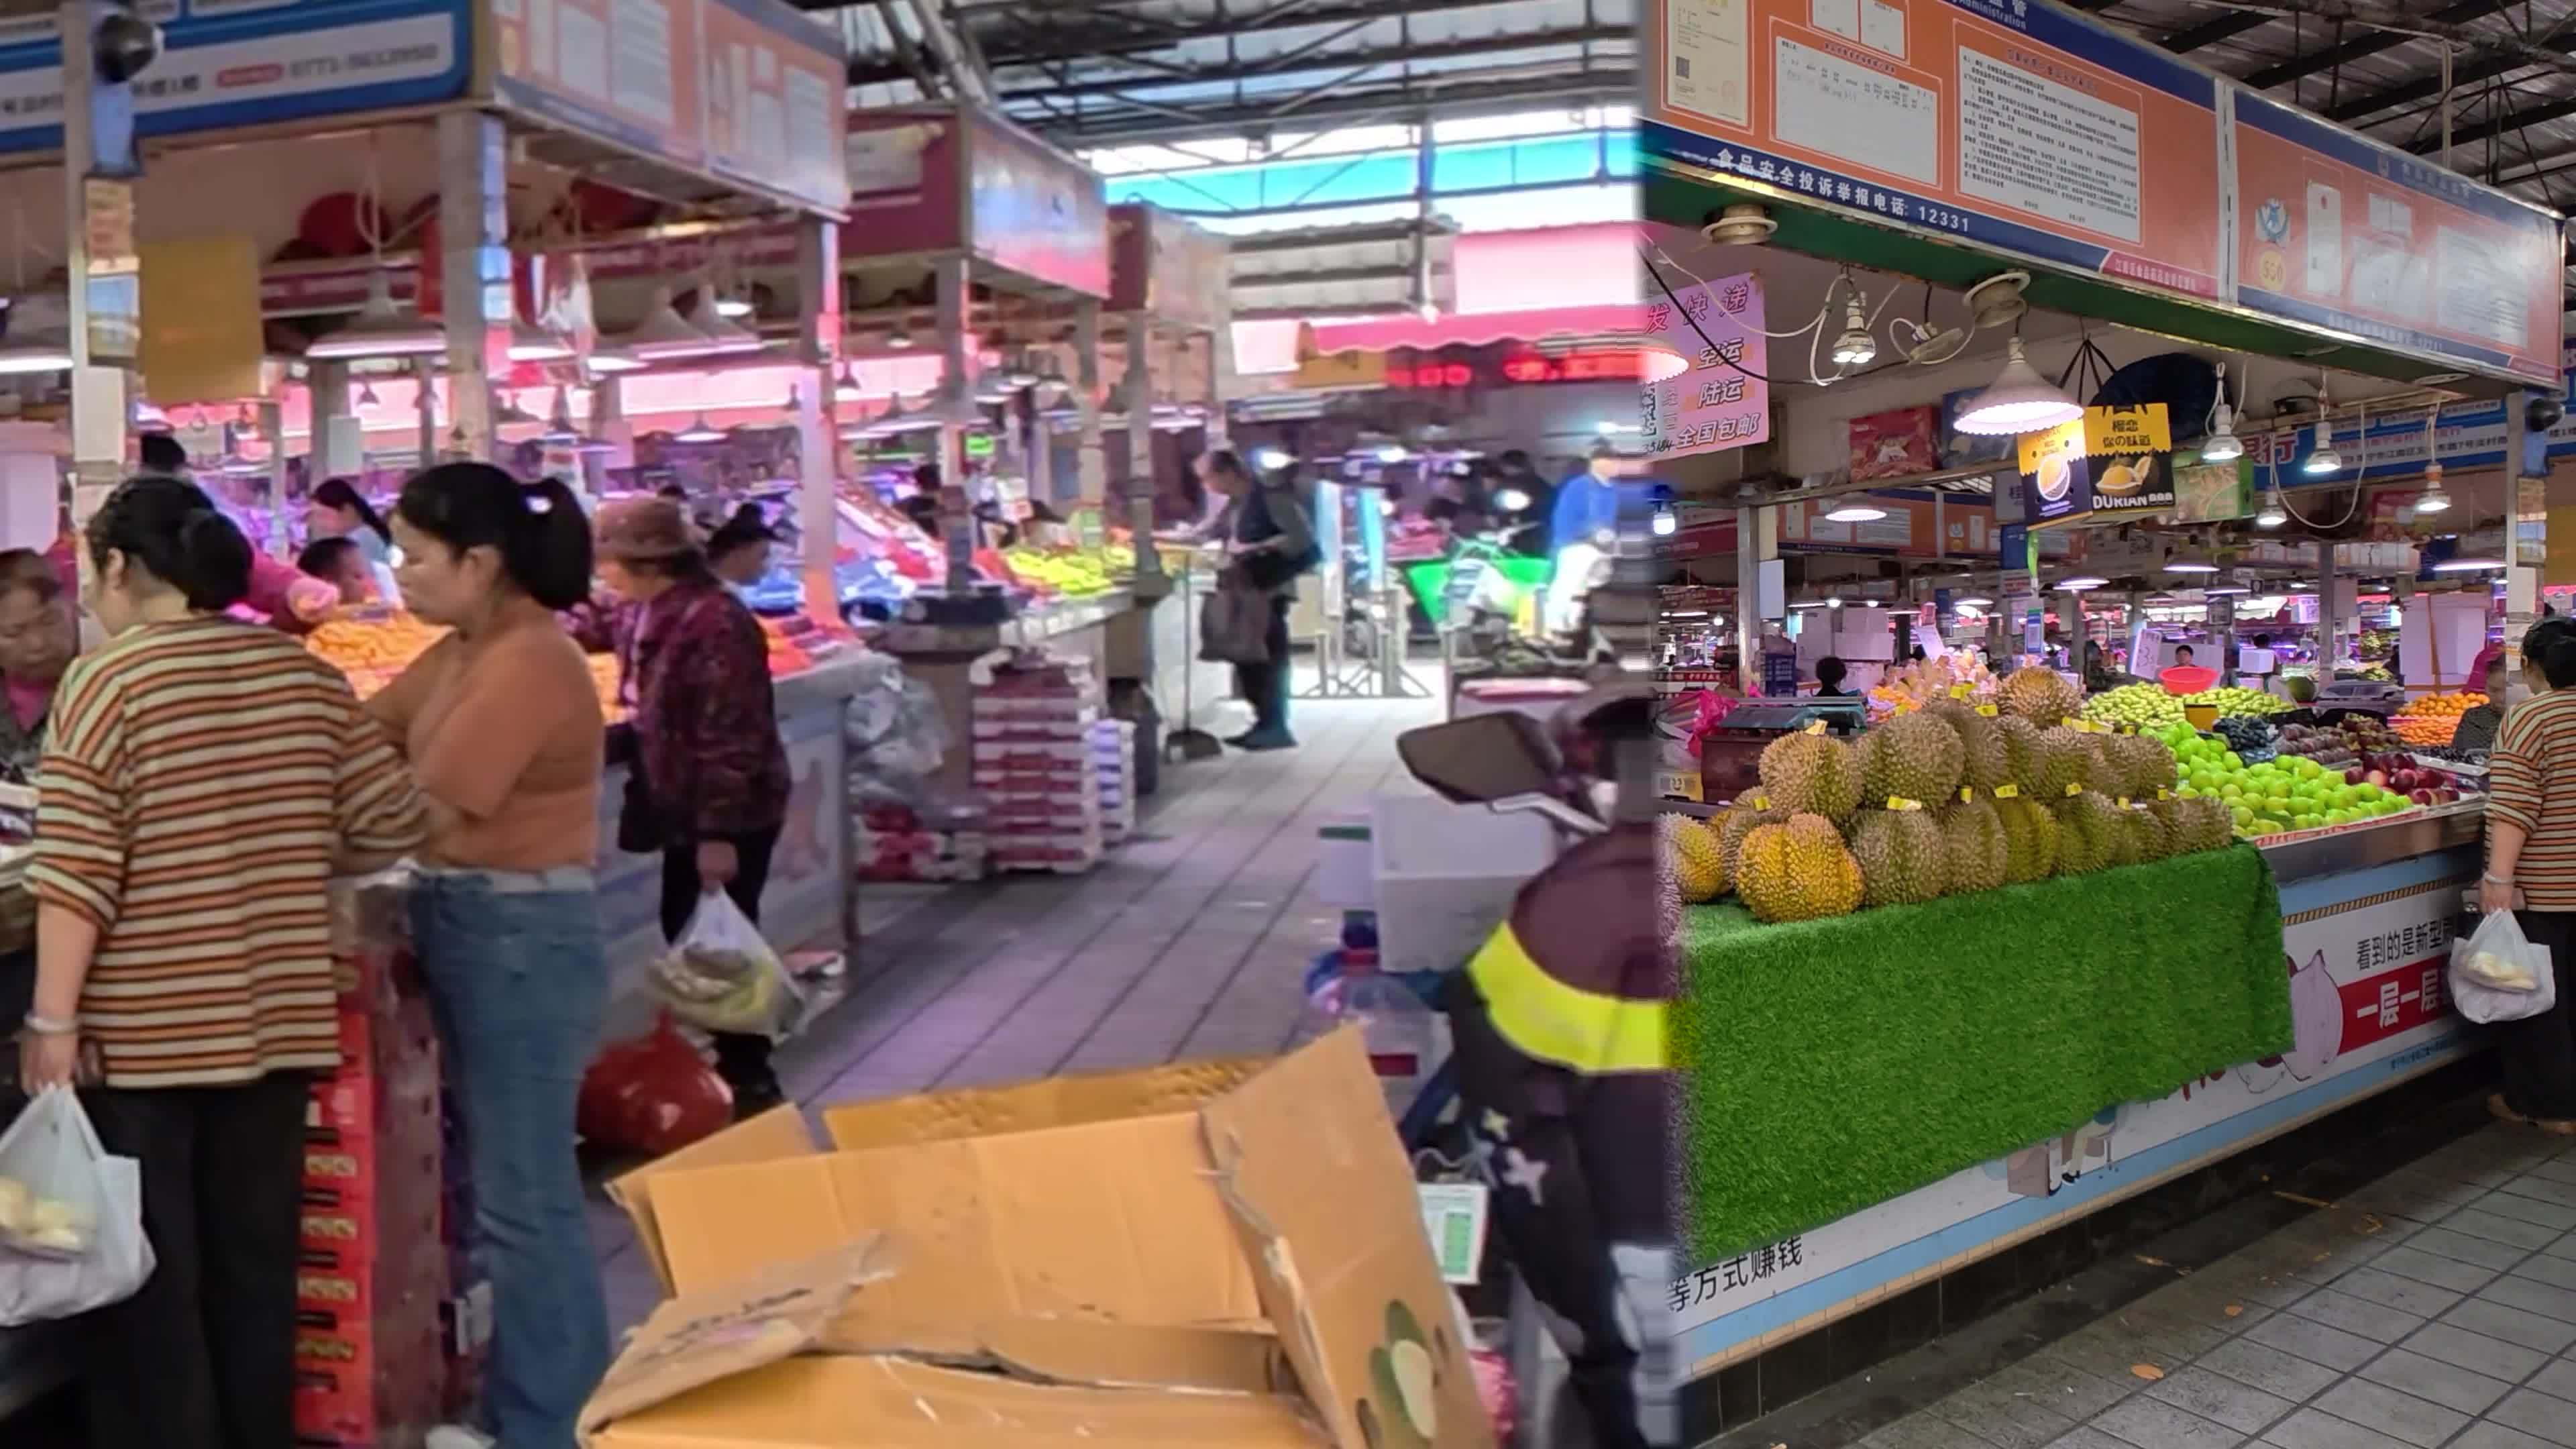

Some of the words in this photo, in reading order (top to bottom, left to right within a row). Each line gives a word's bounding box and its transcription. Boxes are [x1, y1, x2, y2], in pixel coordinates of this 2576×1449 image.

[1919, 206, 1970, 233] 12331
[1696, 337, 1745, 370] 空运
[1697, 376, 1745, 409] 陆运
[1676, 412, 1761, 449] 全国包邮
[1668, 1235, 1803, 1313] 等方式赚钱
